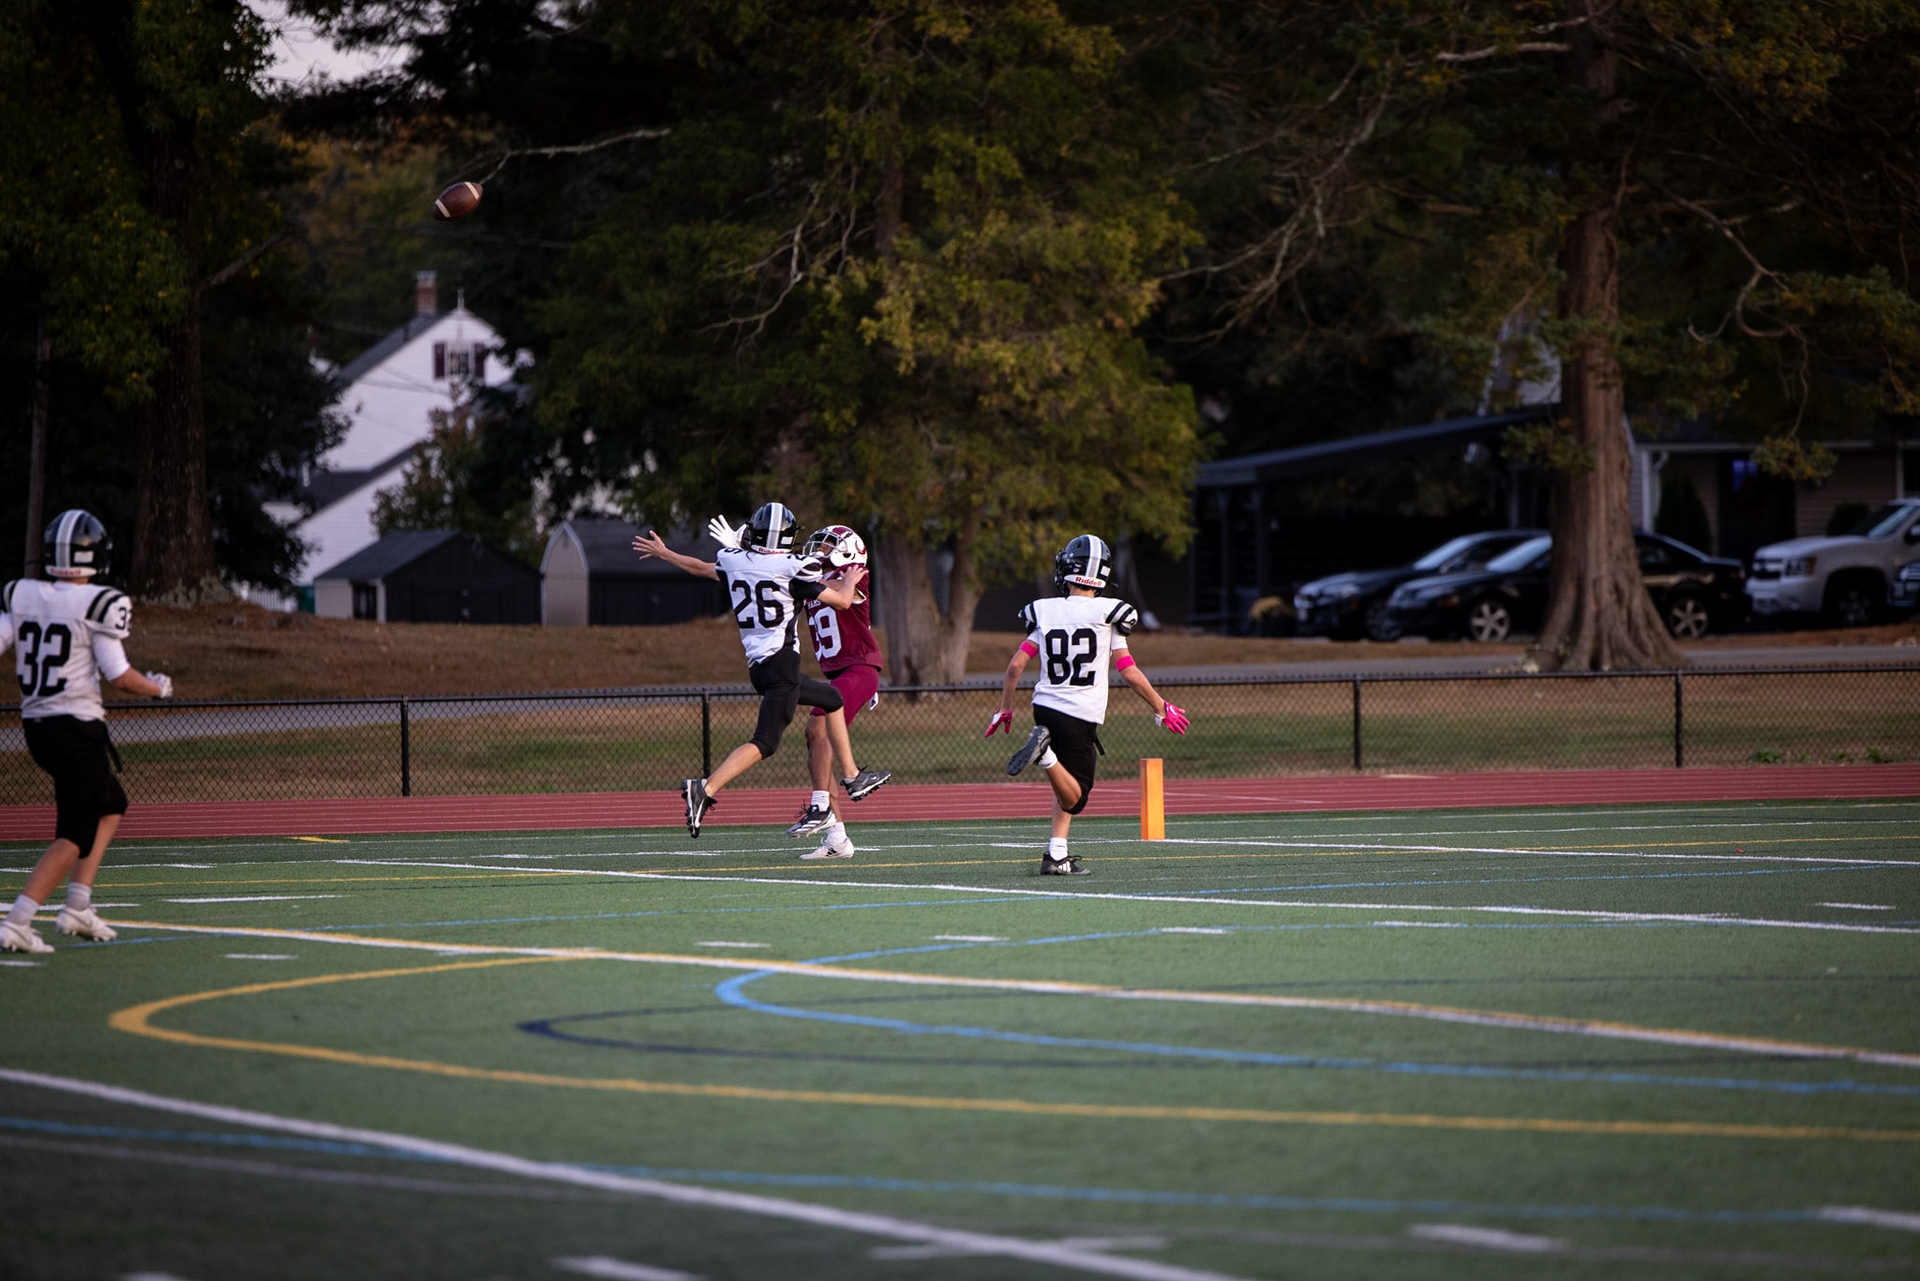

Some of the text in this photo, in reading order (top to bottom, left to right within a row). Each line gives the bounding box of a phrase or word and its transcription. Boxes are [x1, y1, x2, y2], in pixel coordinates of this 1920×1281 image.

[732, 580, 785, 629] 26
[1075, 577, 1103, 587] Riddell
[18, 621, 71, 697] 32
[1045, 628, 1097, 686] 82
